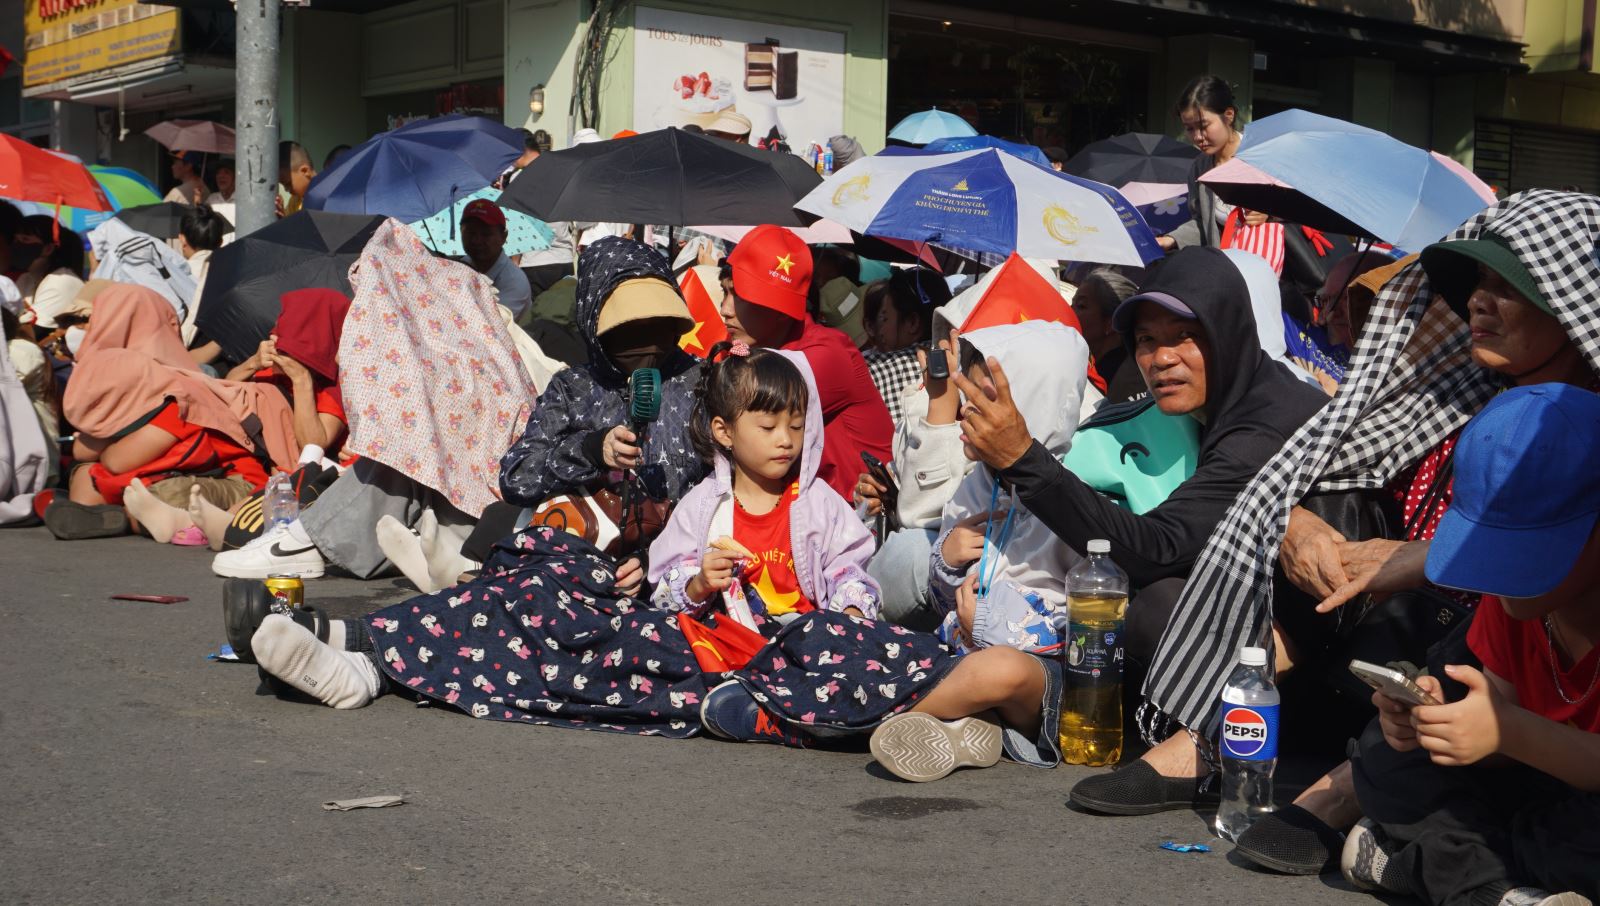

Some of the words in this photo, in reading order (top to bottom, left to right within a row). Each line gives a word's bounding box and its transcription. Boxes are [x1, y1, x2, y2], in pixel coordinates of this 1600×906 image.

[646, 27, 677, 42] TOUS
[690, 33, 723, 47] JOURS
[781, 275, 791, 283] NAM
[762, 548, 785, 564] VIỆT
[1224, 723, 1265, 738] PEPSI
